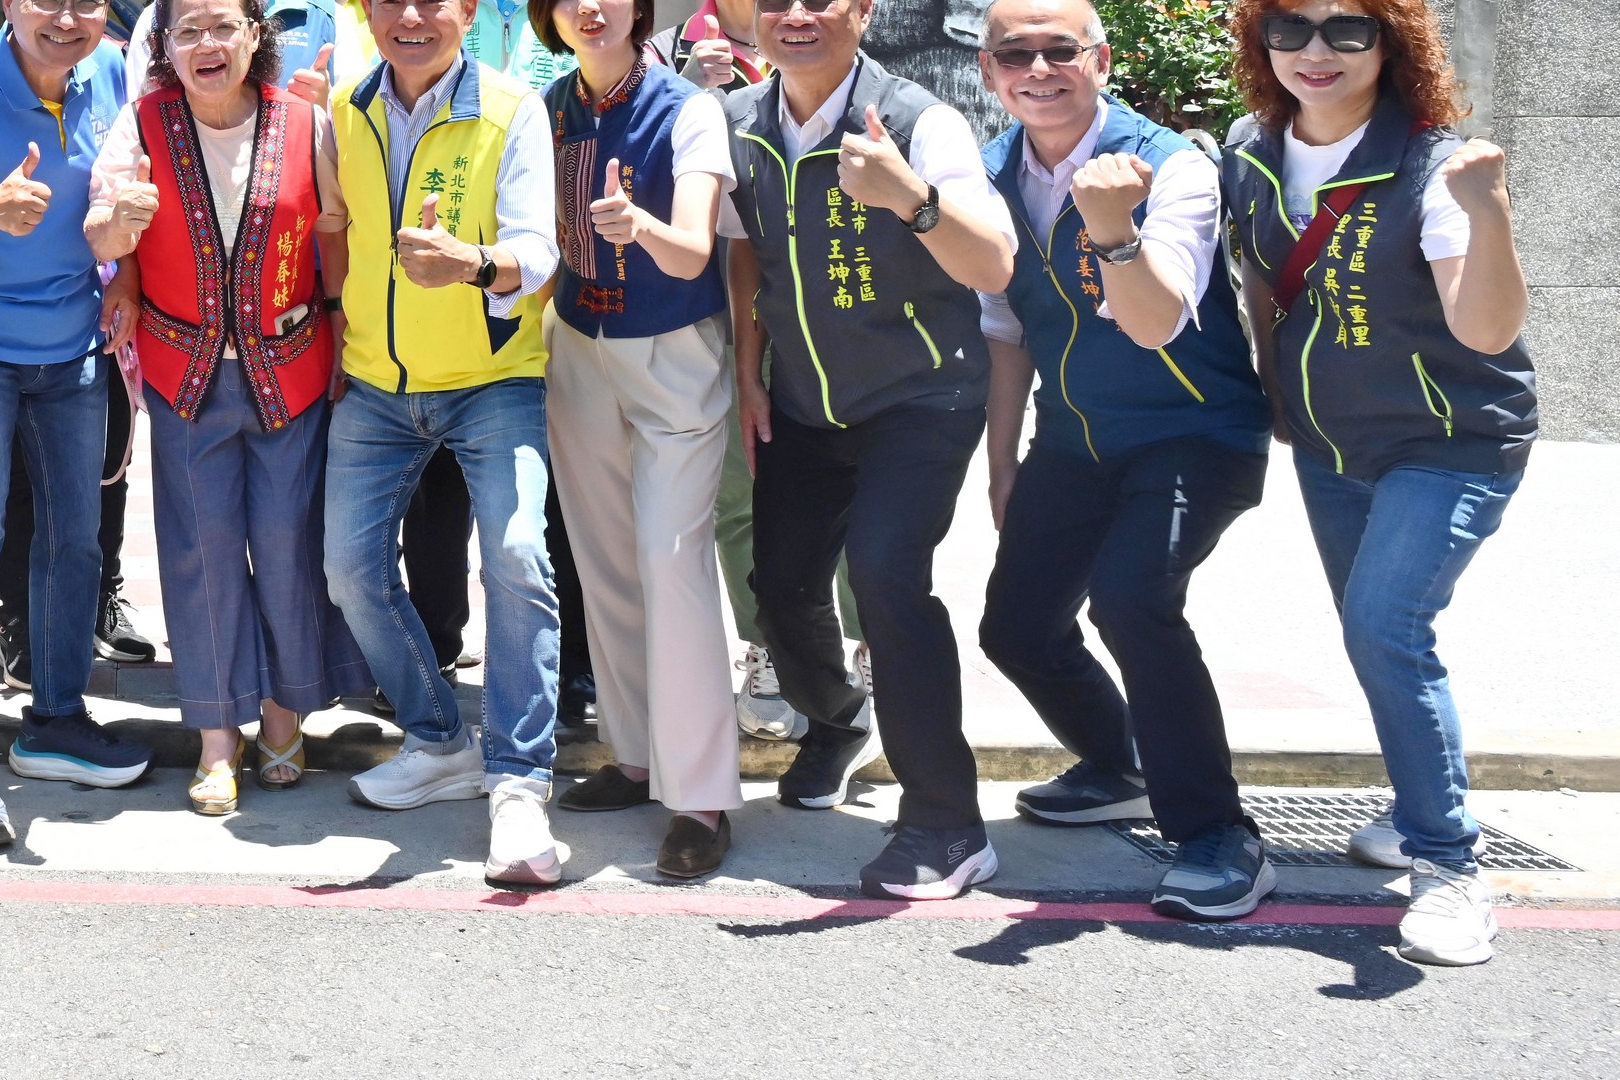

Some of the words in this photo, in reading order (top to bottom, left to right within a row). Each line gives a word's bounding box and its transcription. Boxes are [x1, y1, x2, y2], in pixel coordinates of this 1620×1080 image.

[446, 155, 469, 238] 新北市議員
[826, 186, 846, 229] 區長
[272, 230, 294, 309] 楊春妹
[1327, 213, 1353, 260] 里長
[1349, 202, 1378, 273] 三重區
[827, 238, 853, 310] 王坤南
[854, 246, 877, 302] 三重區
[1346, 285, 1371, 346] 二重里
